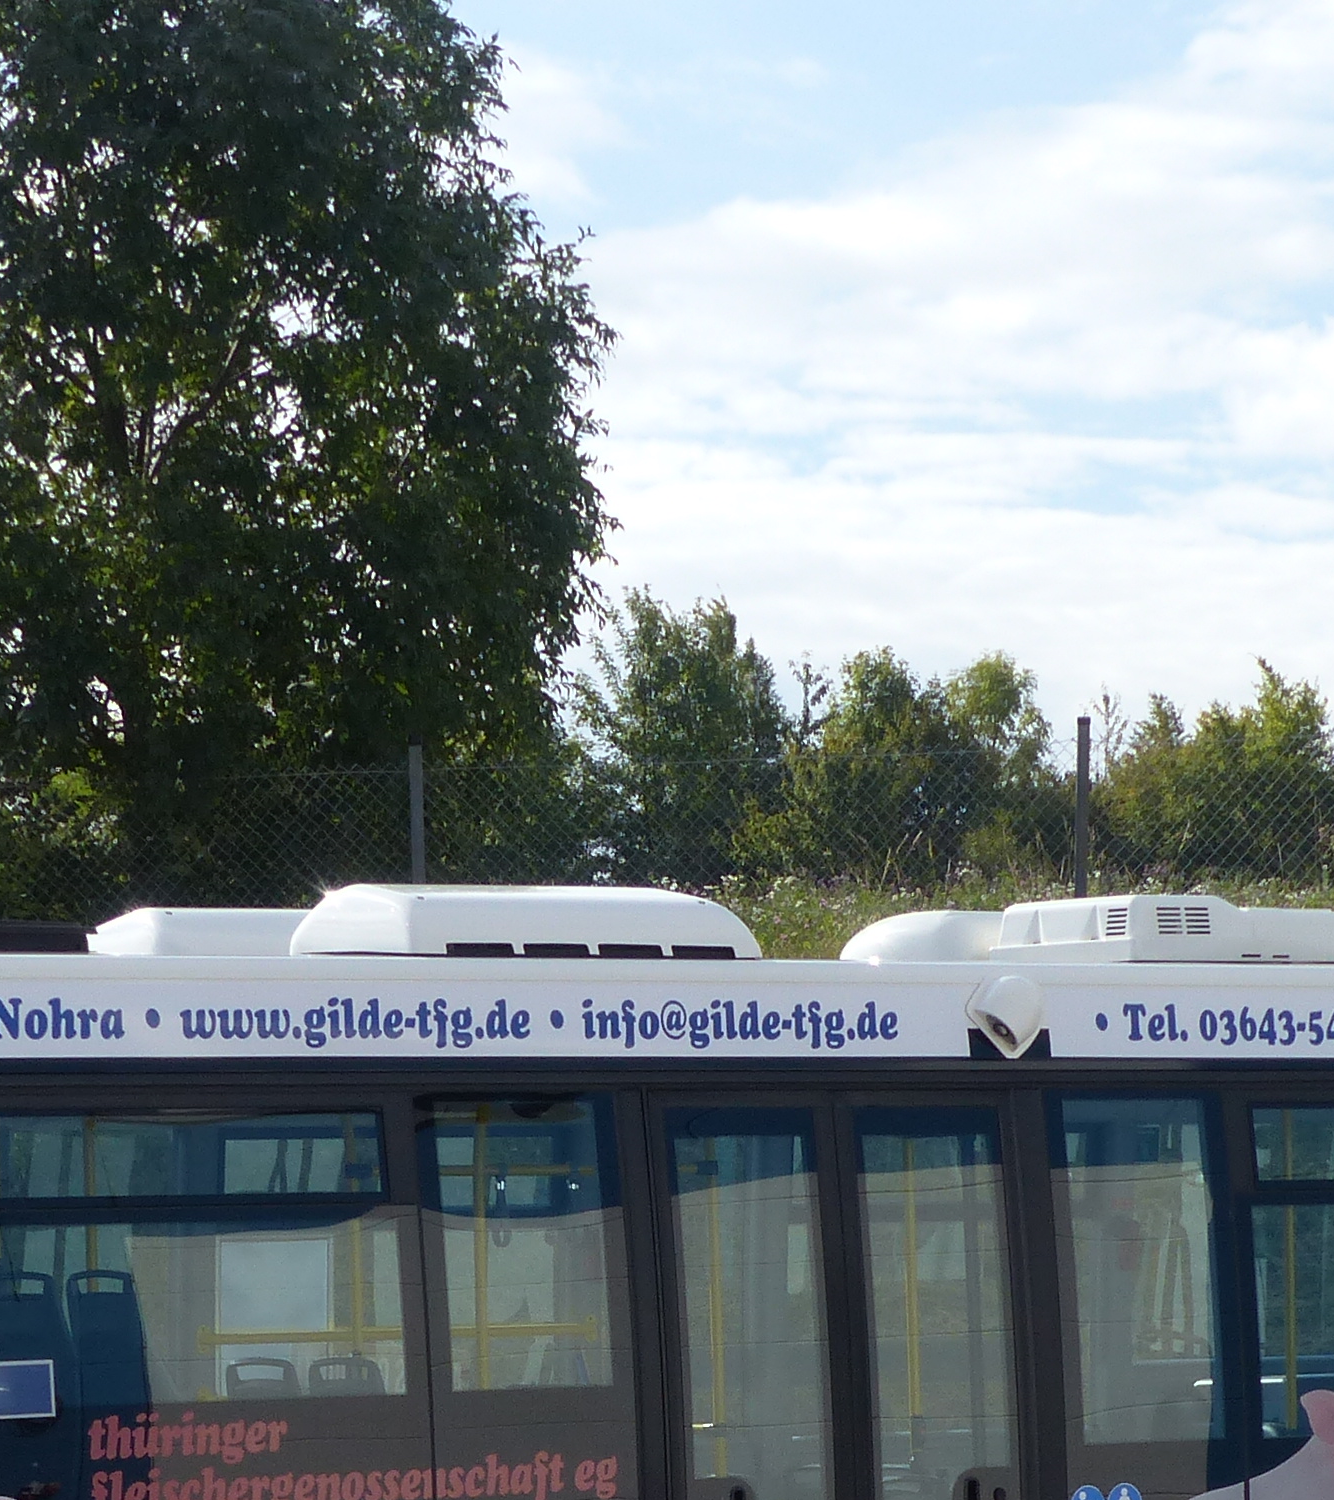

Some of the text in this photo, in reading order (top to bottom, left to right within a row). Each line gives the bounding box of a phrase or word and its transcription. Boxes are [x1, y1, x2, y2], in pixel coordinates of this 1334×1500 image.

[180, 997, 531, 1049] www.gilde-tfg.de
[581, 999, 899, 1050] info@gilde-tfg.de
[1123, 1002, 1188, 1042] Tel.
[88, 1410, 289, 1465] thüringer
[574, 1455, 618, 1499] eg
